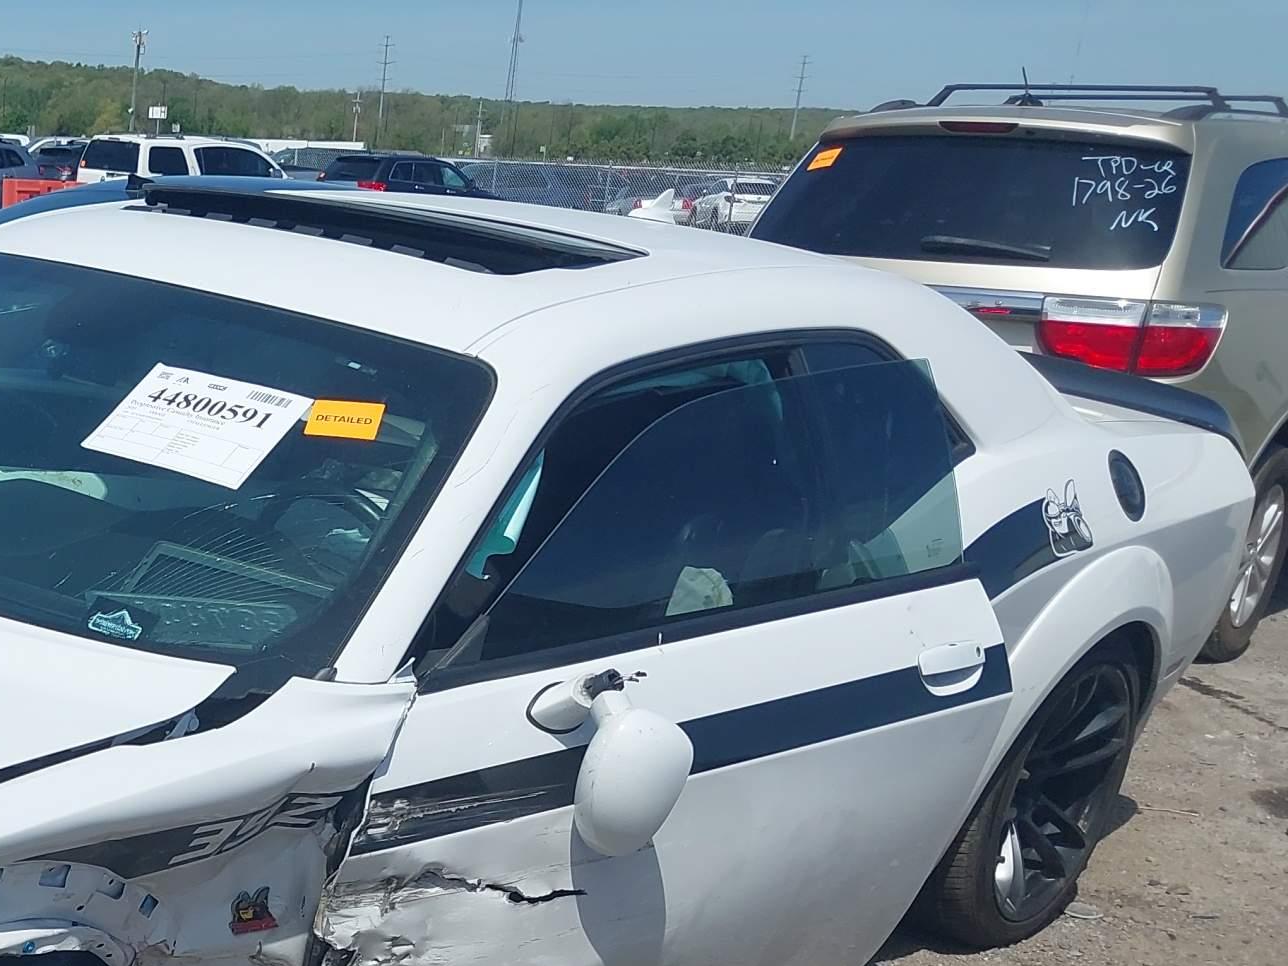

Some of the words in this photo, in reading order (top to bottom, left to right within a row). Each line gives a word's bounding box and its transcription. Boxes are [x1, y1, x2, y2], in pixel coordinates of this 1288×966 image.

[1072, 174, 1176, 206] 1798-26
[147, 387, 273, 430] 44800591
[315, 414, 373, 425] DETAILED
